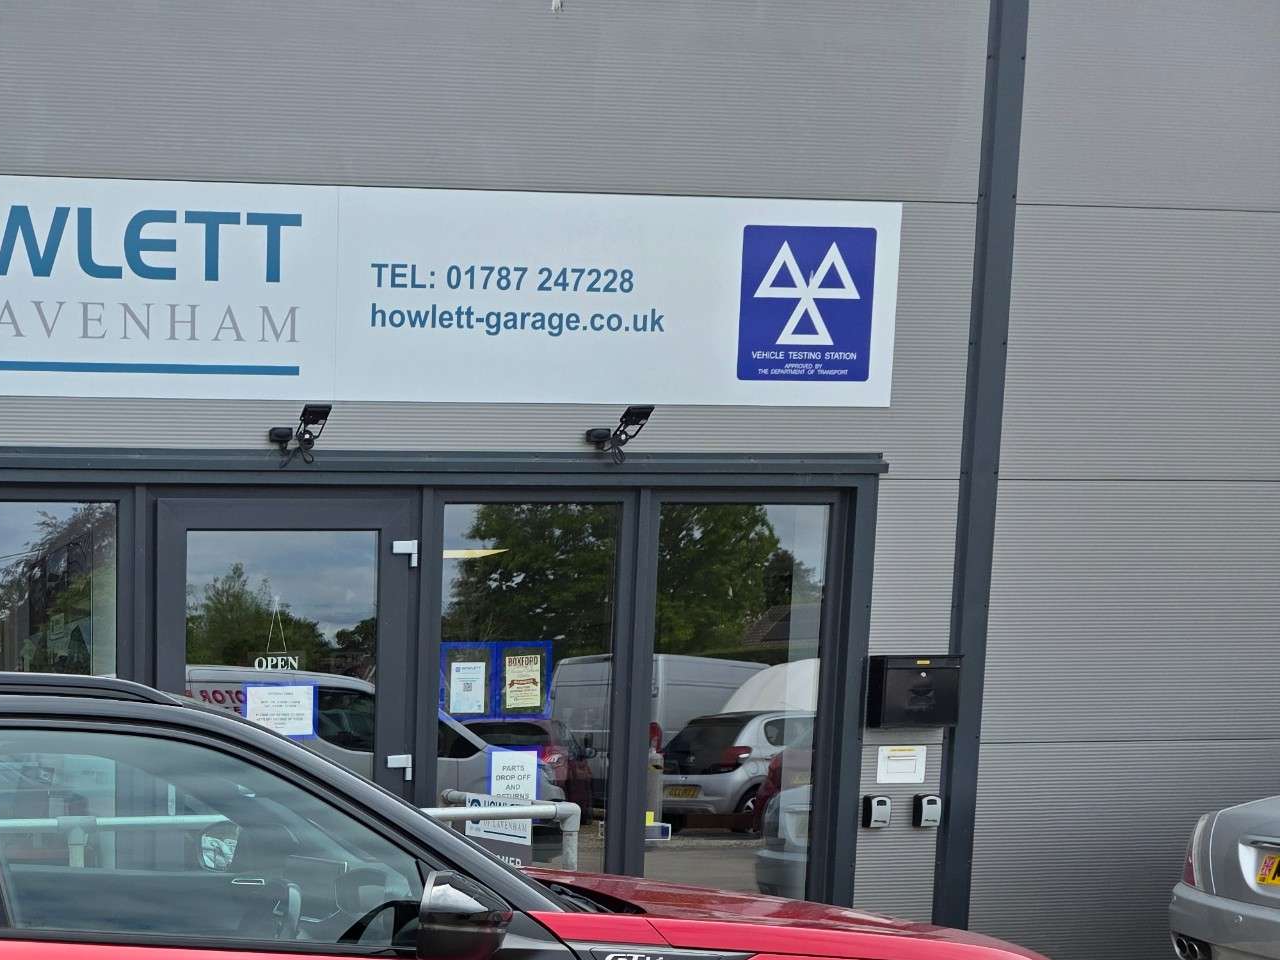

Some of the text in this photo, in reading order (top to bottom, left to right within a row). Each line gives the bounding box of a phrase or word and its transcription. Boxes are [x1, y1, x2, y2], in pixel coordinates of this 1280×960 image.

[371, 263, 634, 293] TEL: 01787 247228
[370, 302, 665, 337] howlett-garage.co.uk
[751, 350, 857, 361] VEHICLE TESTING STATION
[254, 656, 300, 671] OPEN
